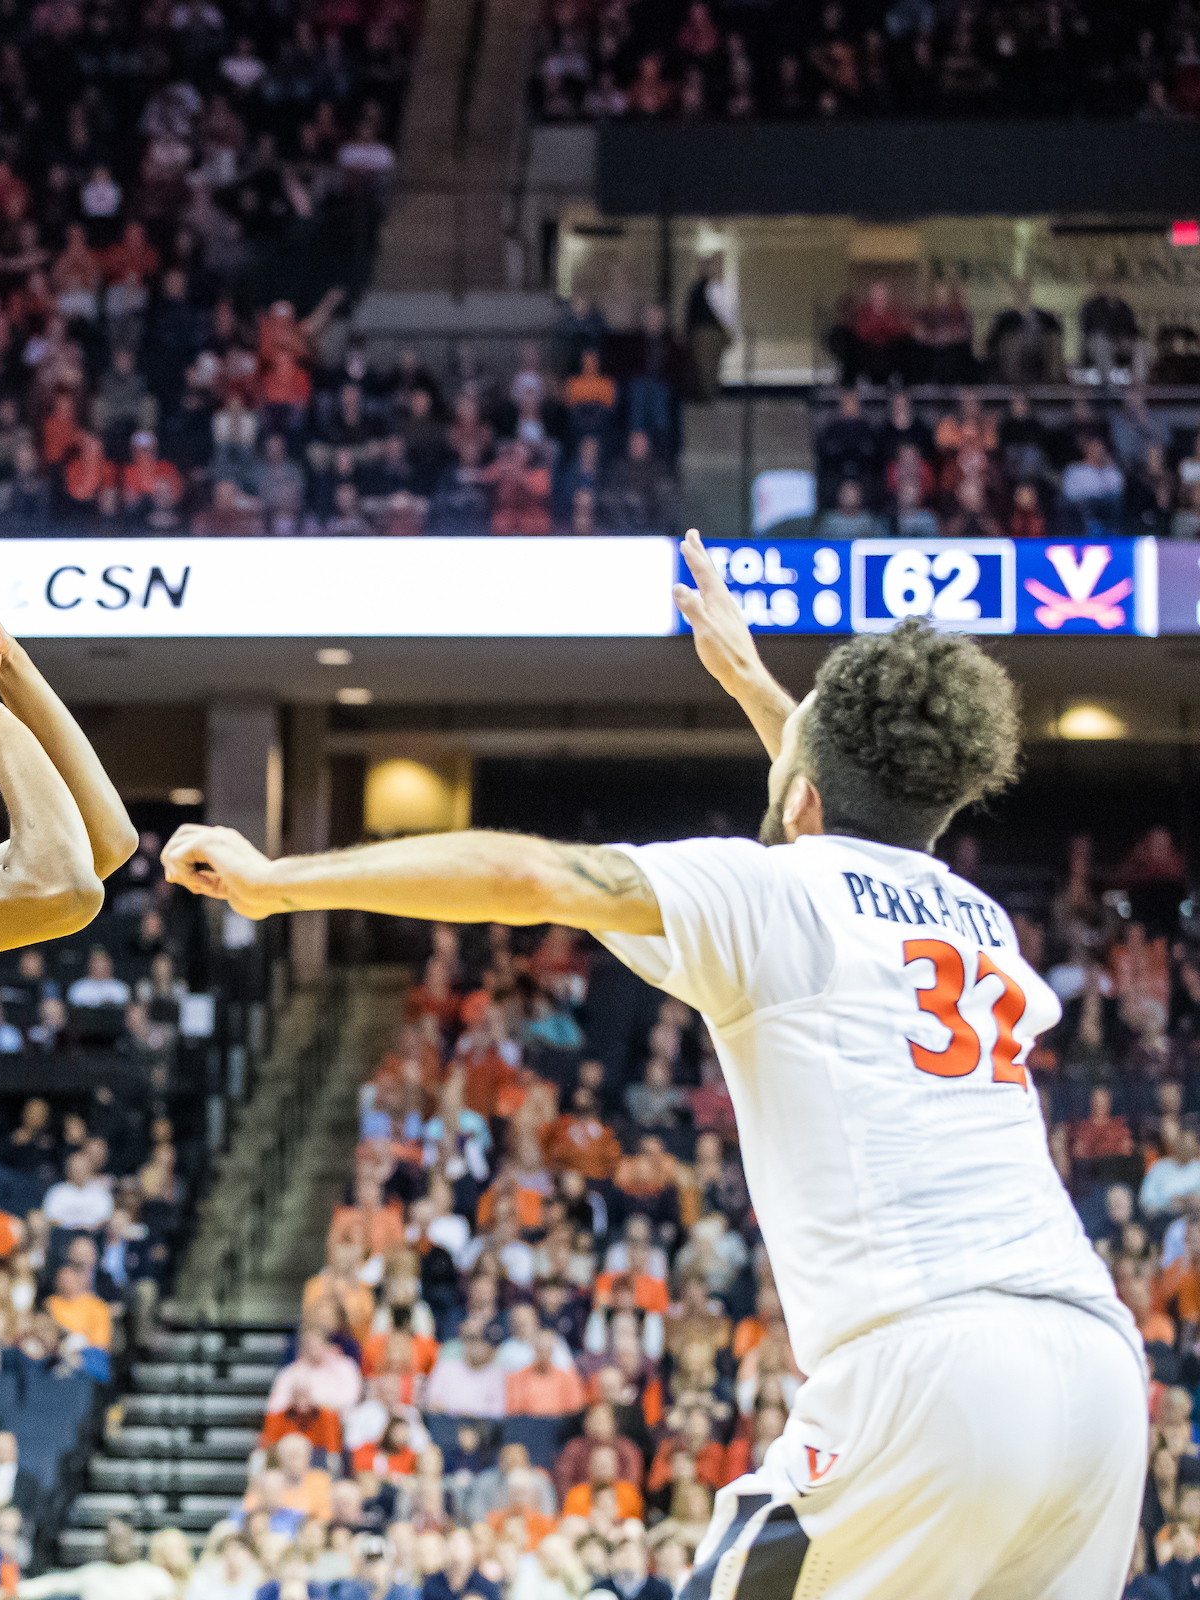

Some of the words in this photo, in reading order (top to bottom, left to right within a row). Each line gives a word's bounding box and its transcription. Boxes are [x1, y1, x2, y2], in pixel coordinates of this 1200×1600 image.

[45, 565, 190, 610] CSN
[882, 549, 982, 621] 62
[902, 938, 1028, 1093] 32
[803, 1444, 839, 1482] V
